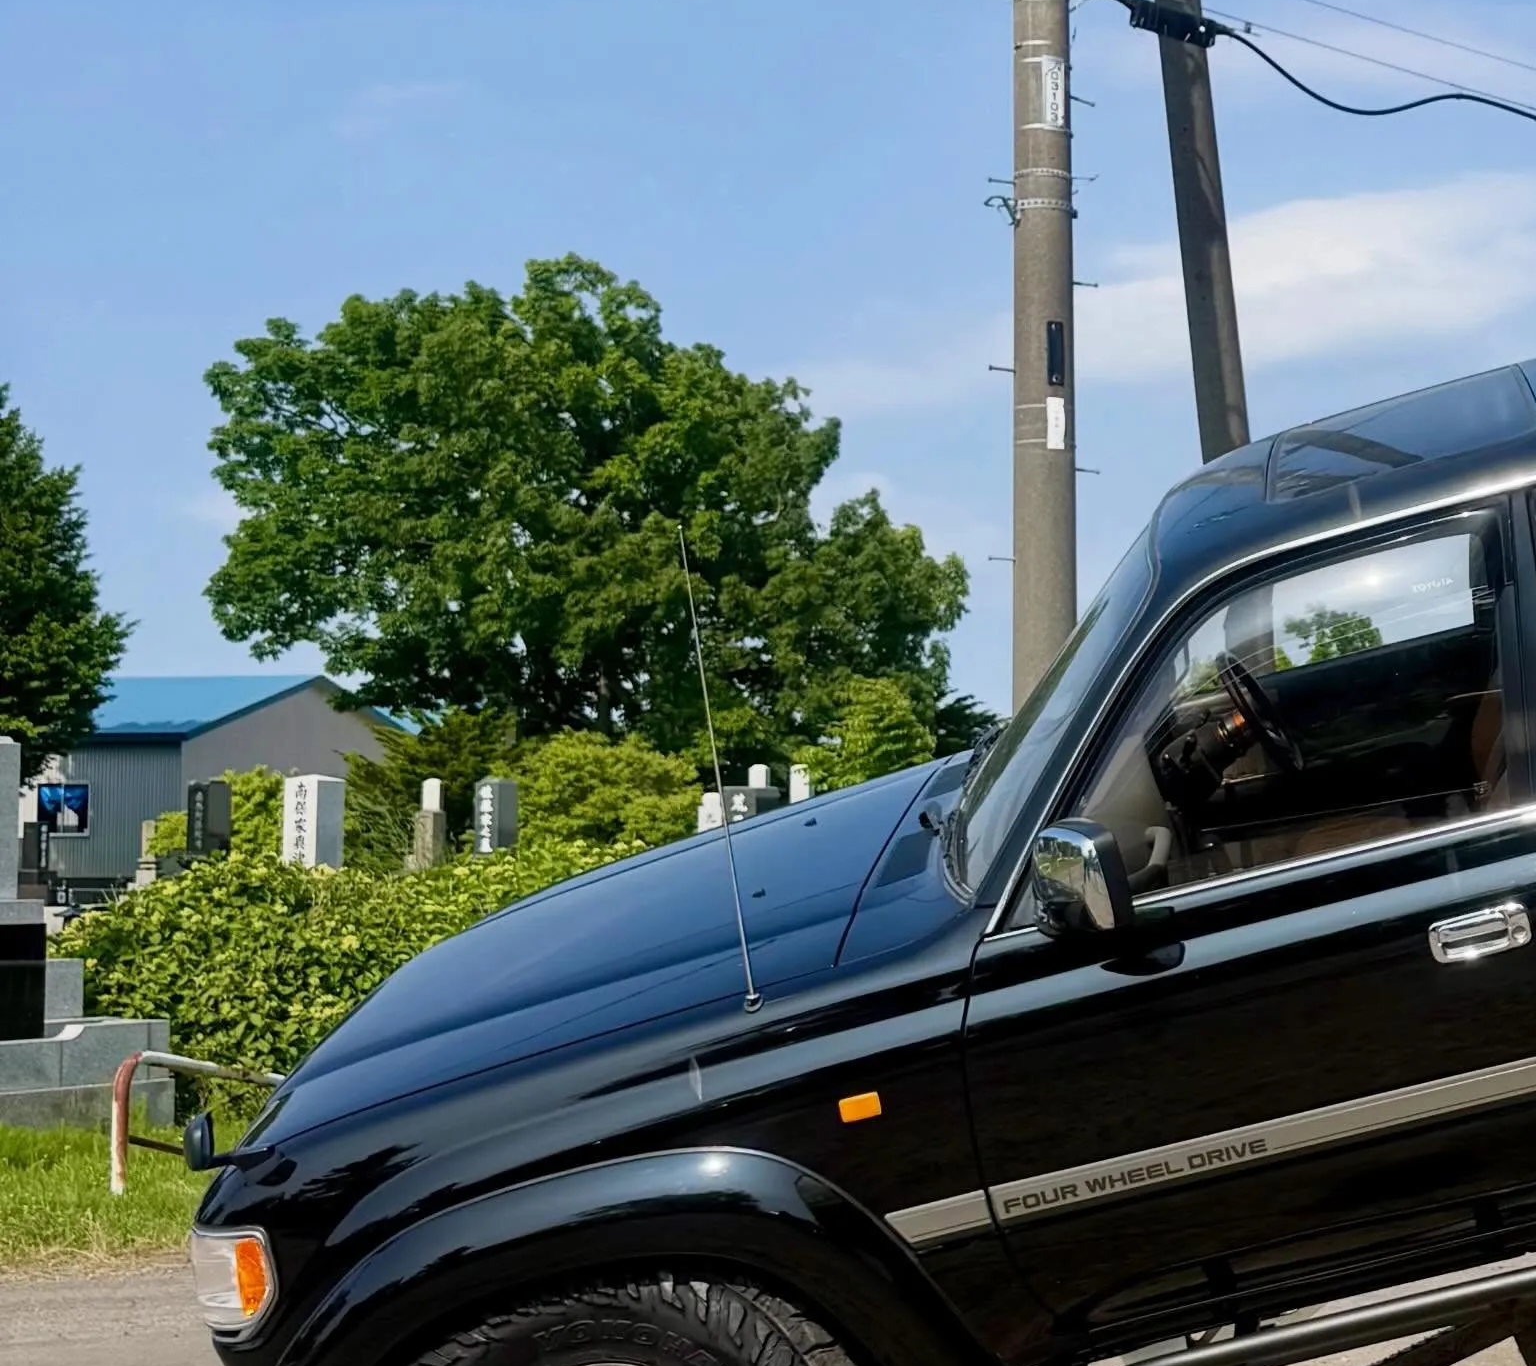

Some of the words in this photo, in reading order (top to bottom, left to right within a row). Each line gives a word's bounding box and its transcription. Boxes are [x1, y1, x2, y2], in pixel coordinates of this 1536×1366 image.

[1003, 1184, 1079, 1214] FOUR
[1085, 1161, 1184, 1194] WHEEL
[1187, 1138, 1268, 1170] DRIVE
